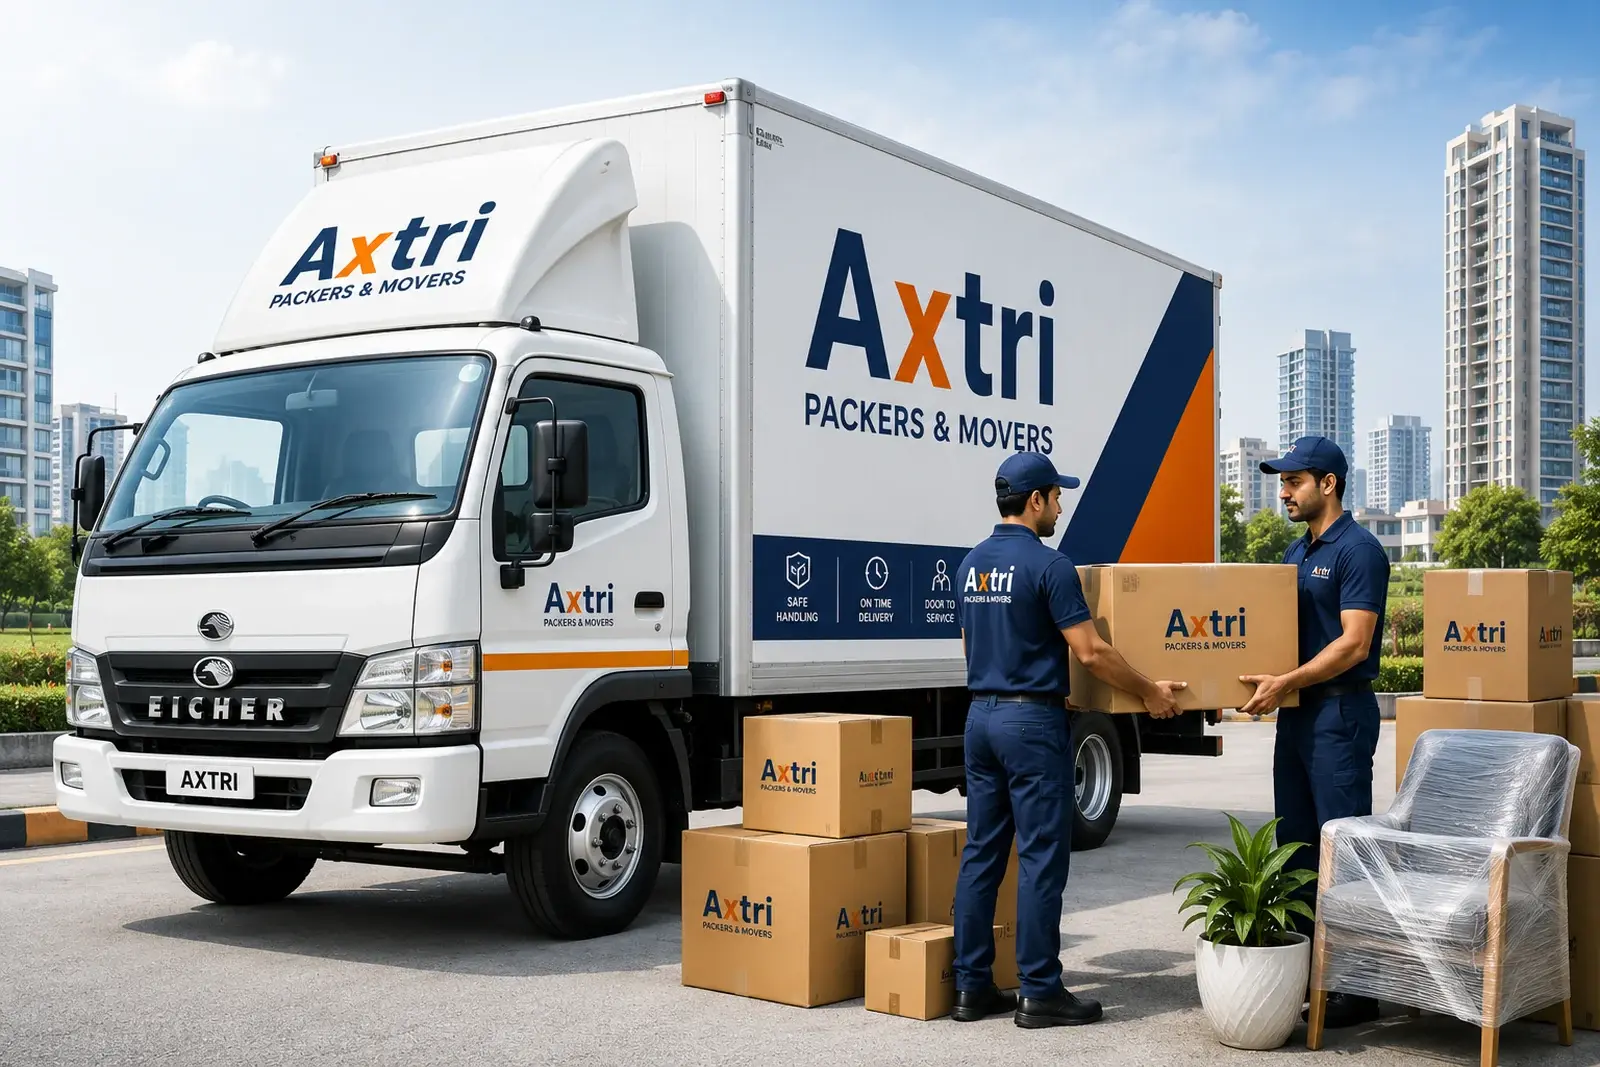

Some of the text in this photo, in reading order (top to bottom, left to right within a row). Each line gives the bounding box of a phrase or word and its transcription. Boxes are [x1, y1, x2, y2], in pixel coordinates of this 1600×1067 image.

[279, 201, 497, 287] Axtri
[269, 270, 466, 309] PACKERS & MOVERS
[805, 228, 1055, 406] Axtri
[804, 392, 1054, 455] PACKERS & MOVERS
[963, 565, 1015, 592] Axtri
[543, 582, 614, 614] Axtri
[787, 596, 808, 608] SAFE
[860, 598, 892, 609] ON TIME
[924, 599, 955, 609] DOOR TO
[543, 618, 614, 627] PACKERS & MOVERS
[776, 611, 819, 622] HANDLING
[858, 612, 894, 622] DELIVERY
[926, 613, 955, 623] SERVICE
[1165, 606, 1246, 638] Axtri
[1444, 620, 1506, 643] Axtri
[1165, 641, 1246, 651] PACKERS & MOVERS
[148, 695, 285, 721] EICHER
[180, 769, 239, 792] AXTRI
[760, 758, 817, 785] Axtri
[702, 889, 773, 927] Axtri
[836, 900, 882, 931] Axtri
[702, 921, 773, 939] PACKERS & MOVERS
